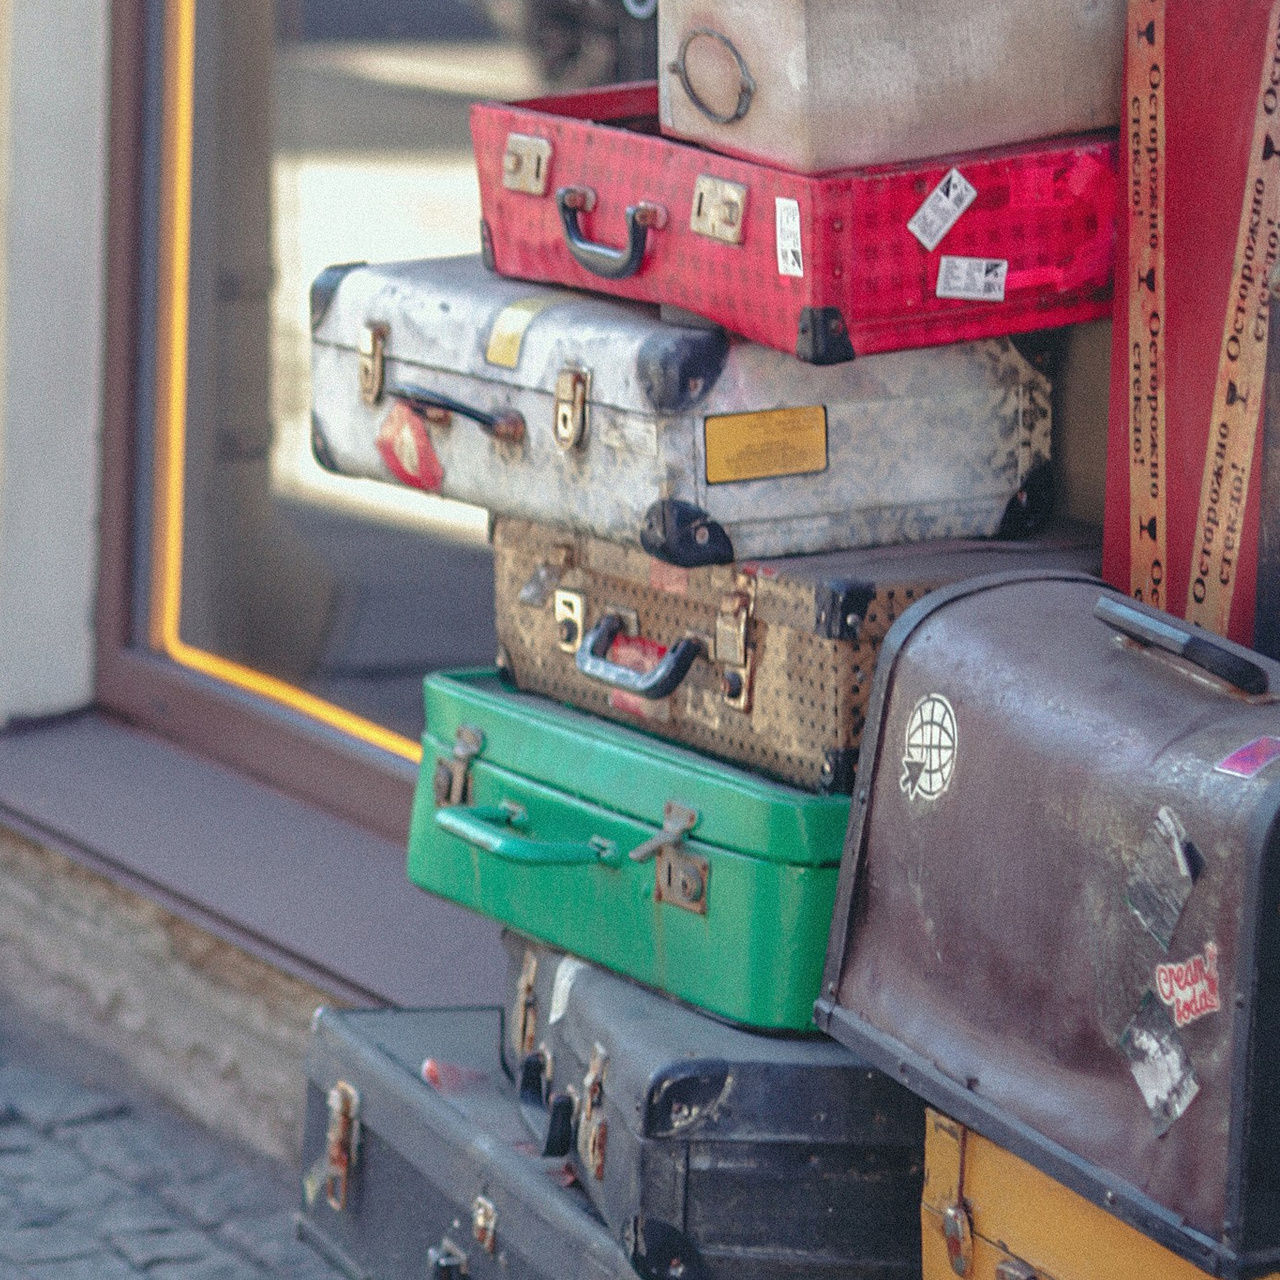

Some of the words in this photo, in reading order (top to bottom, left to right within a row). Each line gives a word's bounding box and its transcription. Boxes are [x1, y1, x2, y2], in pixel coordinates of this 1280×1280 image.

[1131, 95, 1145, 217] стекло!
[1146, 63, 1162, 250] Осторожно
[1226, 177, 1266, 362] Осторожно
[1132, 340, 1146, 467] стекло!
[1148, 311, 1163, 500] Осторожно
[1192, 421, 1231, 605] Осторожно
[1220, 462, 1246, 587] стекло!
